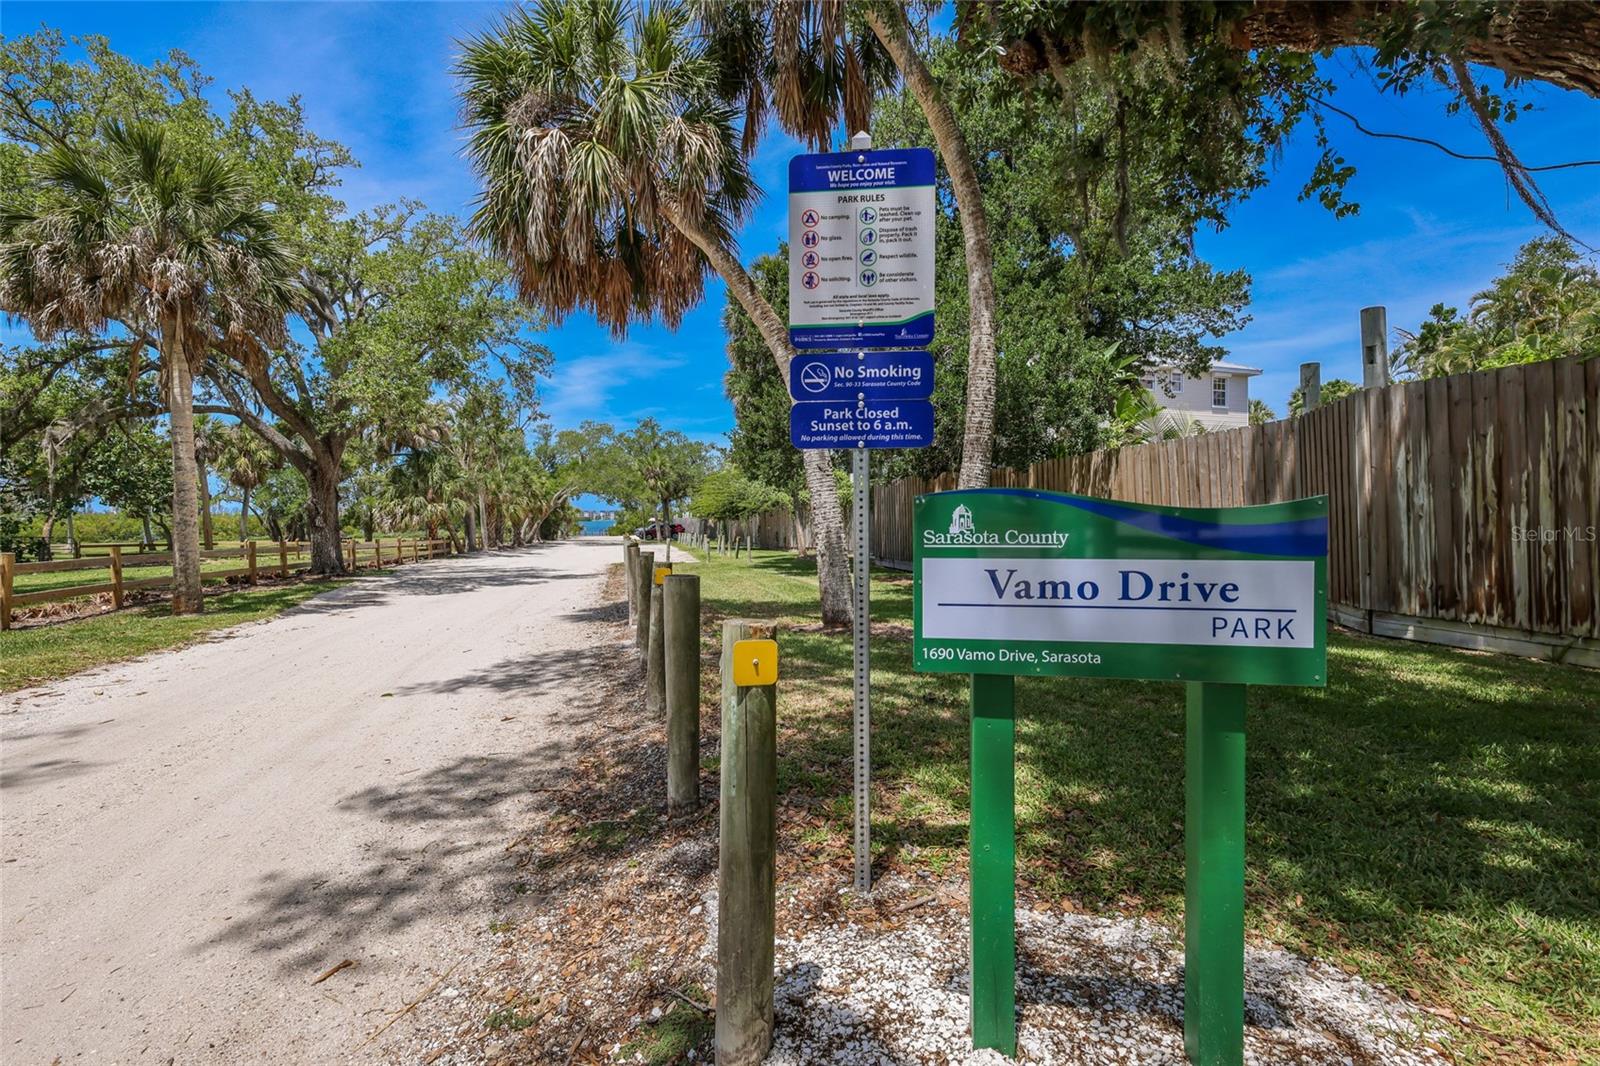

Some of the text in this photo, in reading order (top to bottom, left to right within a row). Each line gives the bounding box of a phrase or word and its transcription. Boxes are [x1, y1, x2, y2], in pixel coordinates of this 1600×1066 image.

[828, 168, 895, 182] WELCOME
[838, 194, 885, 204] PARK RULES
[834, 364, 921, 380] No Smoking
[824, 407, 899, 420] Park Closed
[811, 420, 912, 431] Sunset to 6 a.m.
[811, 434, 838, 442] parking
[923, 530, 1069, 548] Sarasota County
[984, 569, 1240, 602] Vamo Drive
[1212, 616, 1295, 640] PARK
[922, 648, 1101, 664] 1690 Vamo Drive, Sarasota
